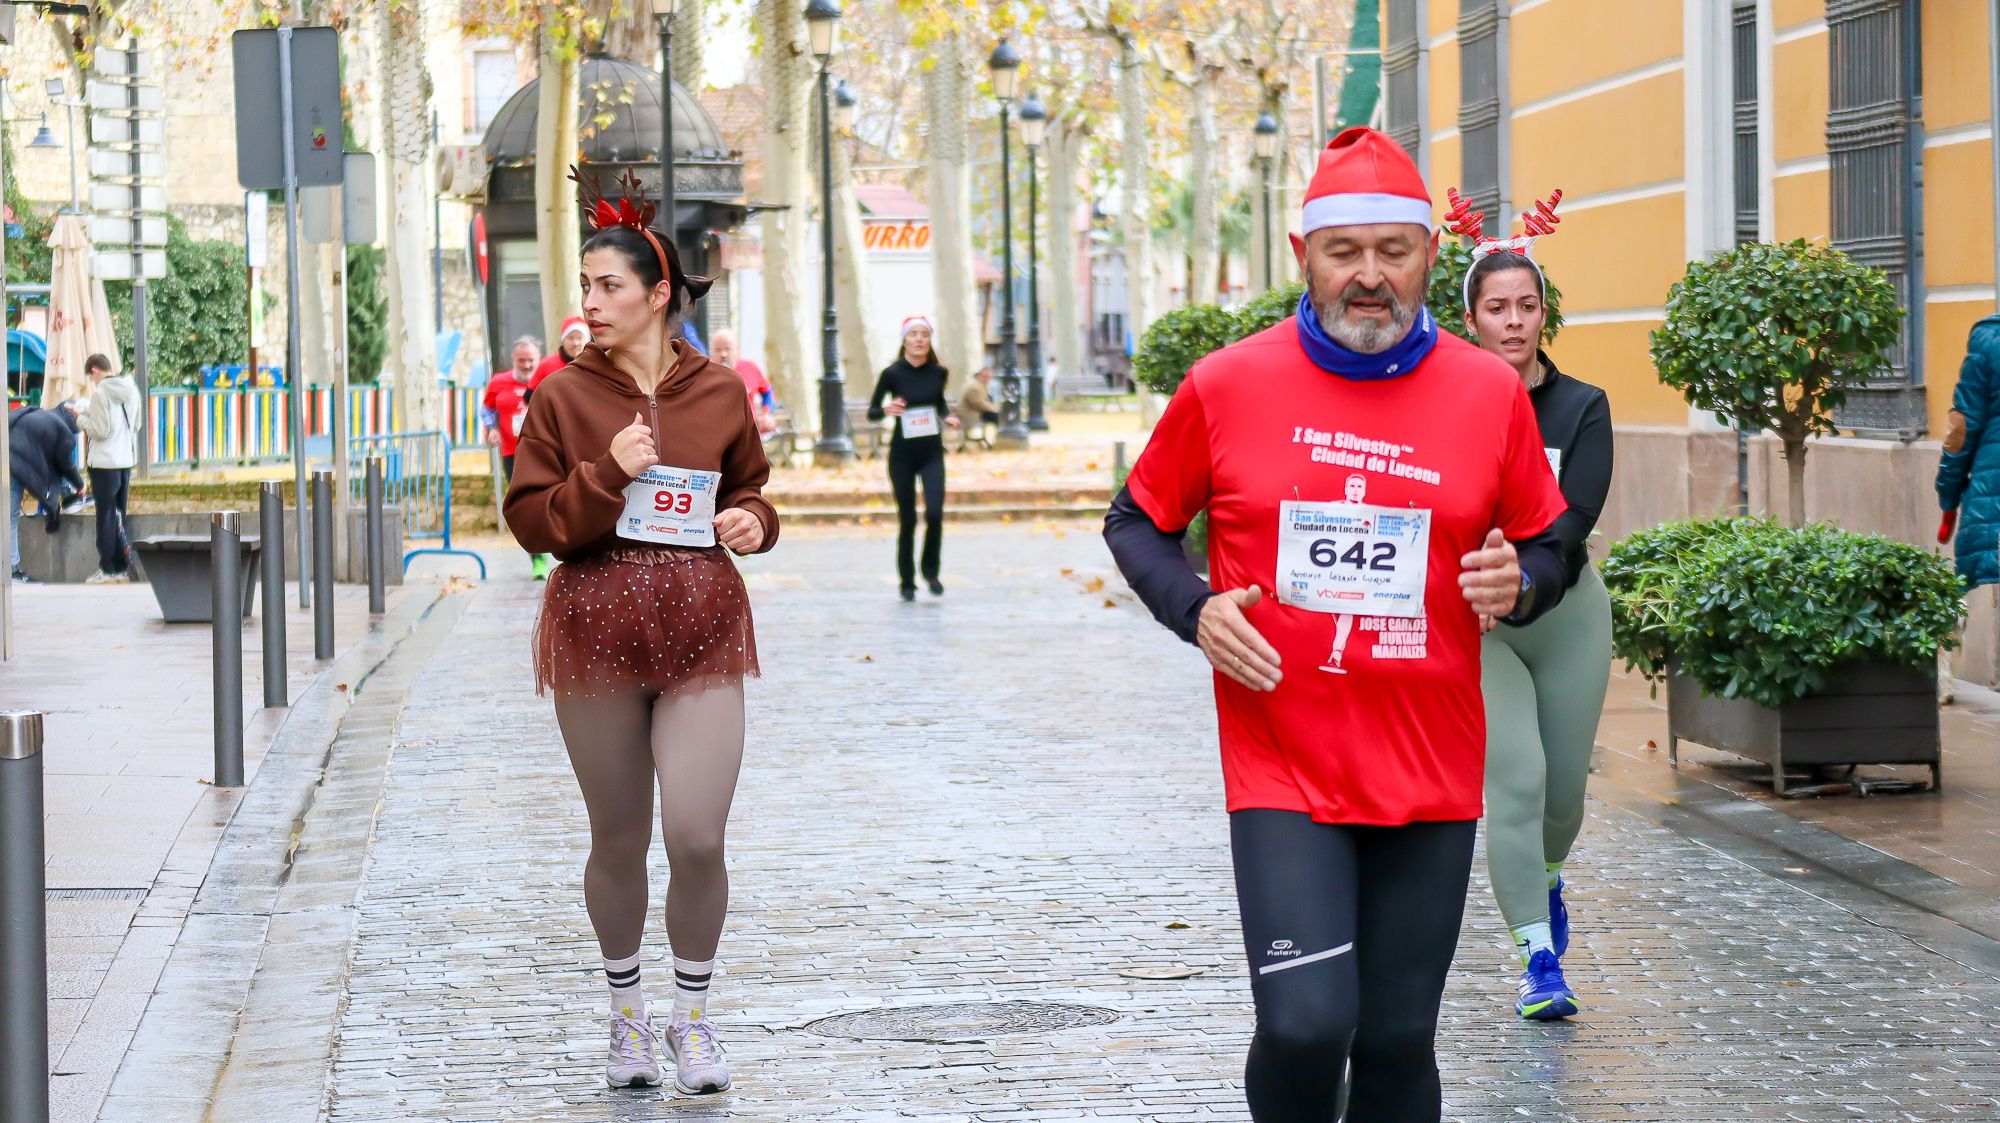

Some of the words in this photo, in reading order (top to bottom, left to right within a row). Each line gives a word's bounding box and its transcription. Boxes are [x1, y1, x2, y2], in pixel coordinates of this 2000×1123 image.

[1292, 426, 1303, 443] I
[1303, 427, 1332, 446] San
[1333, 431, 1401, 458] Silvestre
[1310, 446, 1365, 469] Ciudad
[1366, 455, 1387, 473] de
[1388, 459, 1441, 486] Lucena
[654, 490, 692, 514] 93
[1294, 513, 1312, 523] San
[1312, 513, 1352, 525] Silvestre
[1293, 522, 1326, 532] Ciudad
[1326, 523, 1338, 533] de
[1338, 524, 1370, 535] Lucena
[1309, 538, 1397, 572] 642
[1373, 591, 1411, 601] enerplus
[1359, 616, 1388, 632] JOSE
[1388, 617, 1427, 632] CARLOS
[1379, 631, 1427, 646] HURTADO
[1371, 644, 1427, 659] MARJALIZO
